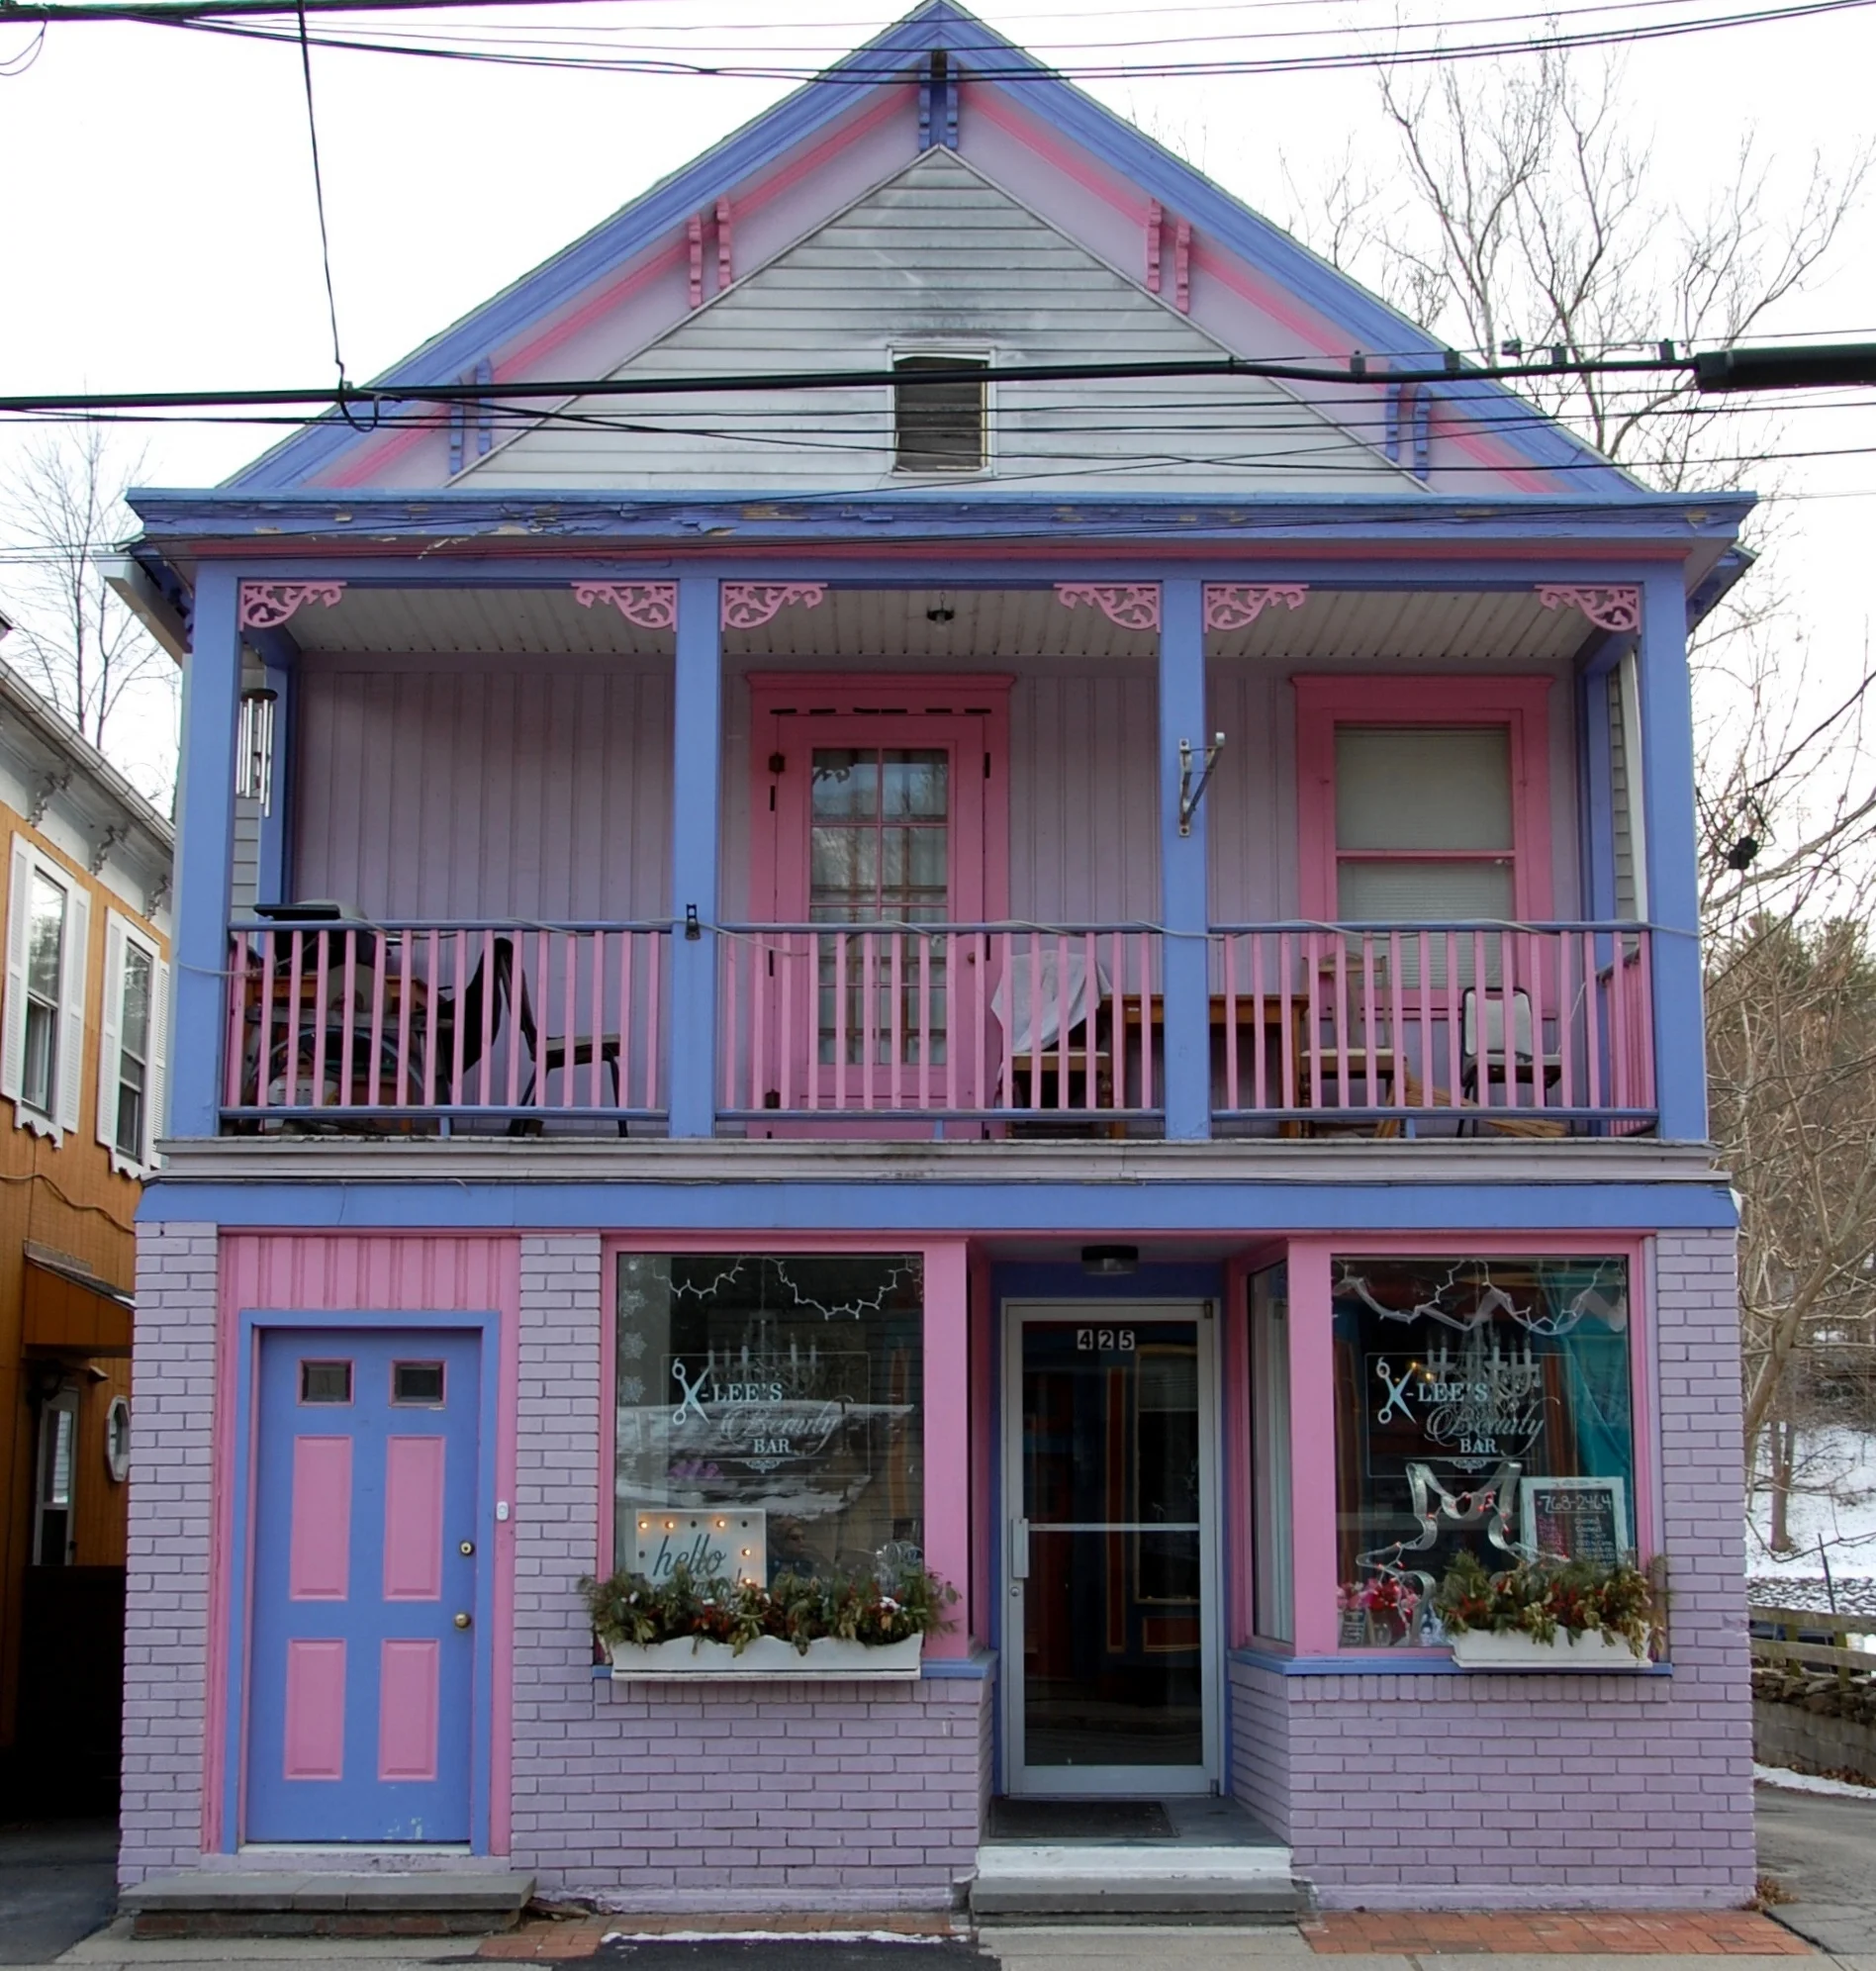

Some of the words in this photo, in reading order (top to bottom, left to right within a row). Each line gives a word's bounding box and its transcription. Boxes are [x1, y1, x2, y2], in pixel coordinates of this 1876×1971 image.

[1079, 1331, 1132, 1349] 425
[720, 1395, 854, 1455] Beauty
[1424, 1396, 1560, 1456] Beauty
[754, 1439, 791, 1454] BAR
[1459, 1439, 1498, 1454] BAR
[1540, 1494, 1612, 1513] 768-2464
[653, 1533, 727, 1577] hello
